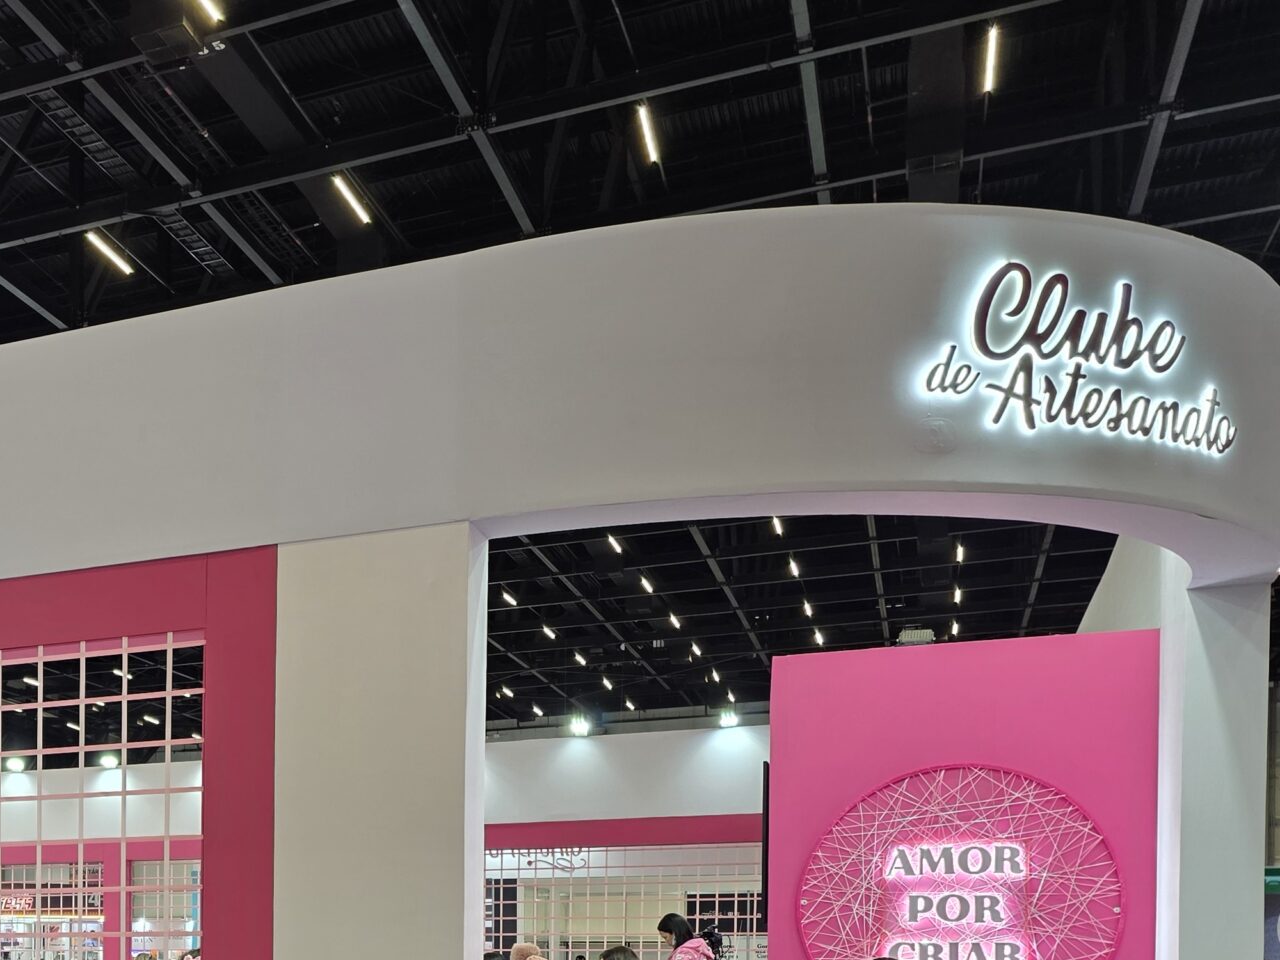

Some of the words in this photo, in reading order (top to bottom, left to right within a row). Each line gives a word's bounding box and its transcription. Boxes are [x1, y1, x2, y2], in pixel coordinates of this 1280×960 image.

[973, 261, 1186, 374] Clube
[925, 345, 981, 394] de
[984, 352, 1237, 454] Artesanato
[887, 846, 1024, 877] AMOR
[908, 894, 1004, 923] POR
